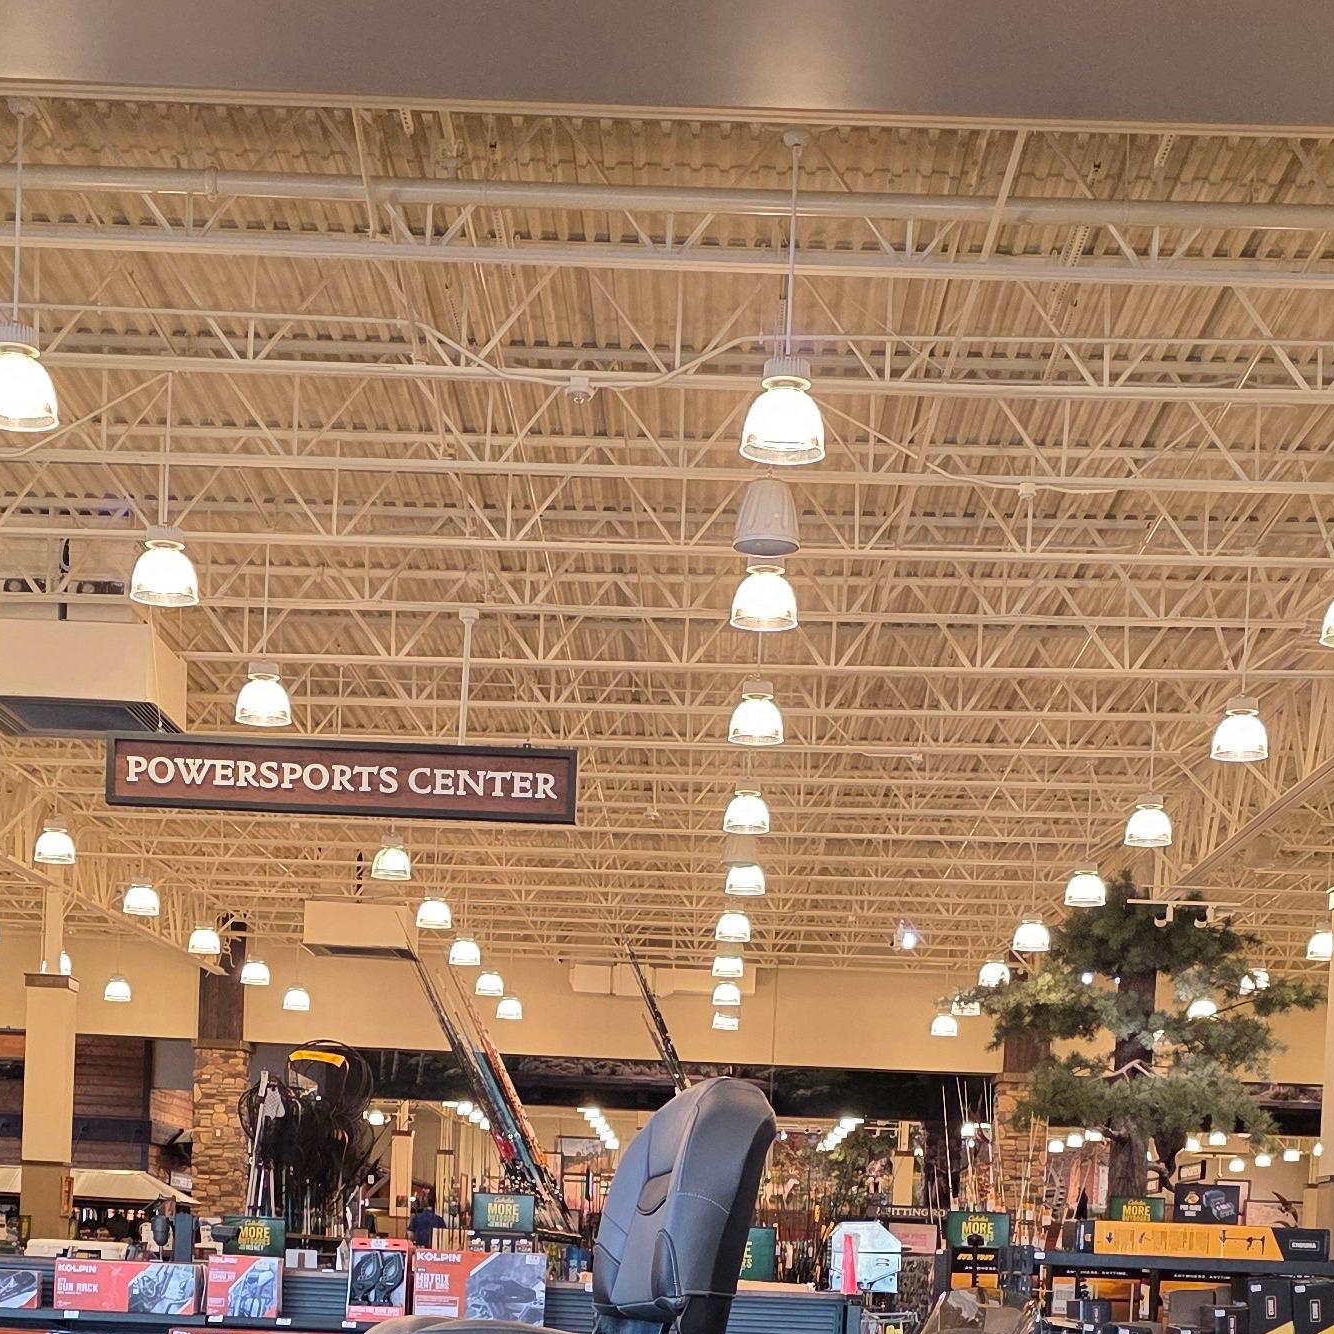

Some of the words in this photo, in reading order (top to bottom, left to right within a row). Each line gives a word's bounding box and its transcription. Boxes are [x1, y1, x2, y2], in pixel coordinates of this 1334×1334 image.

[125, 755, 398, 794] POWERSPORTS
[407, 766, 558, 800] CENTER
[487, 1203, 520, 1216] MORE
[1122, 1205, 1151, 1216] MORE
[239, 1226, 271, 1238] MORE
[961, 1221, 995, 1234] MORE
[416, 1251, 461, 1263] KOLPIN
[57, 1263, 97, 1274] KOLPIN
[416, 1273, 449, 1283] MATRIX
[57, 1283, 74, 1292] GUN
[76, 1283, 98, 1293] RACK
